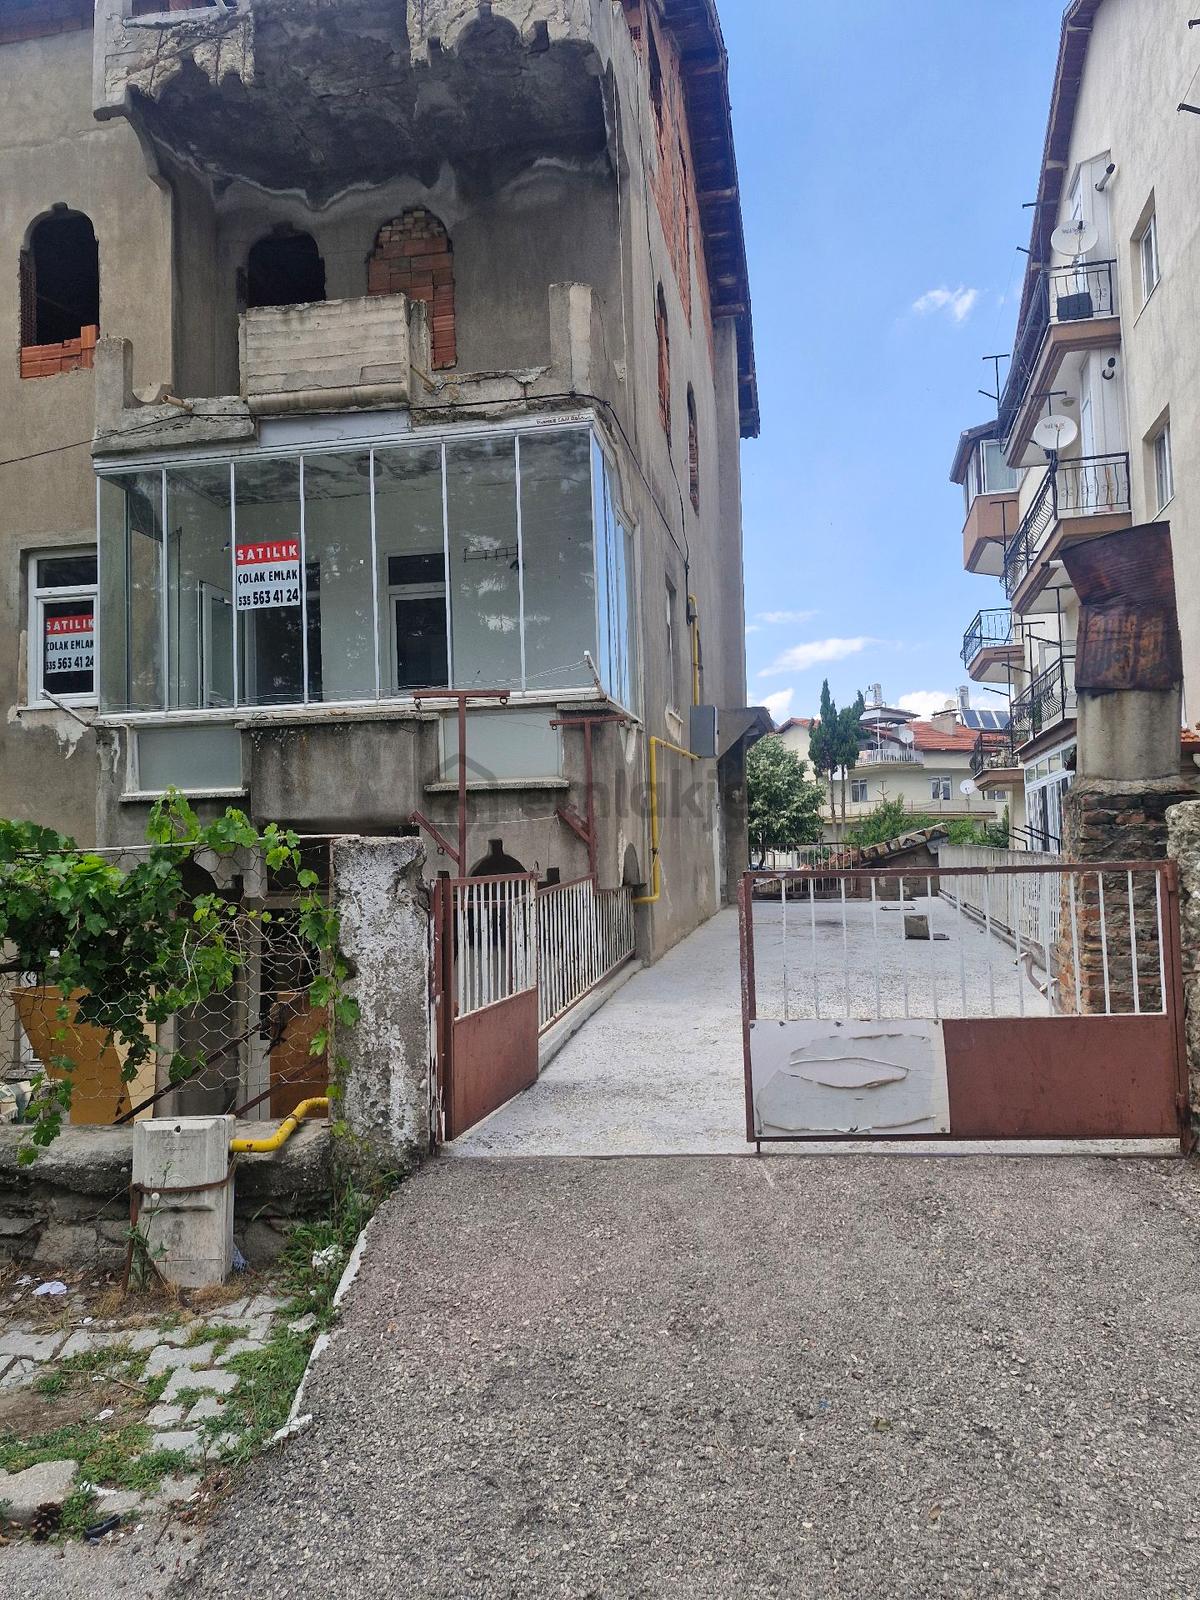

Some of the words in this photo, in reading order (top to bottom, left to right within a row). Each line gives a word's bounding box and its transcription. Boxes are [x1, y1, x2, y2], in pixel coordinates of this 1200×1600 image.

[237, 545, 297, 561] SATILIK
[238, 571, 266, 586] ÇOLAK
[268, 569, 298, 581] EMLAK
[238, 595, 251, 606] 535
[253, 590, 271, 605] 563
[273, 589, 283, 603] 41
[286, 588, 299, 602] 24
[46, 619, 94, 631] SATILIK
[57, 657, 72, 670] 563
[74, 656, 83, 668] 41
